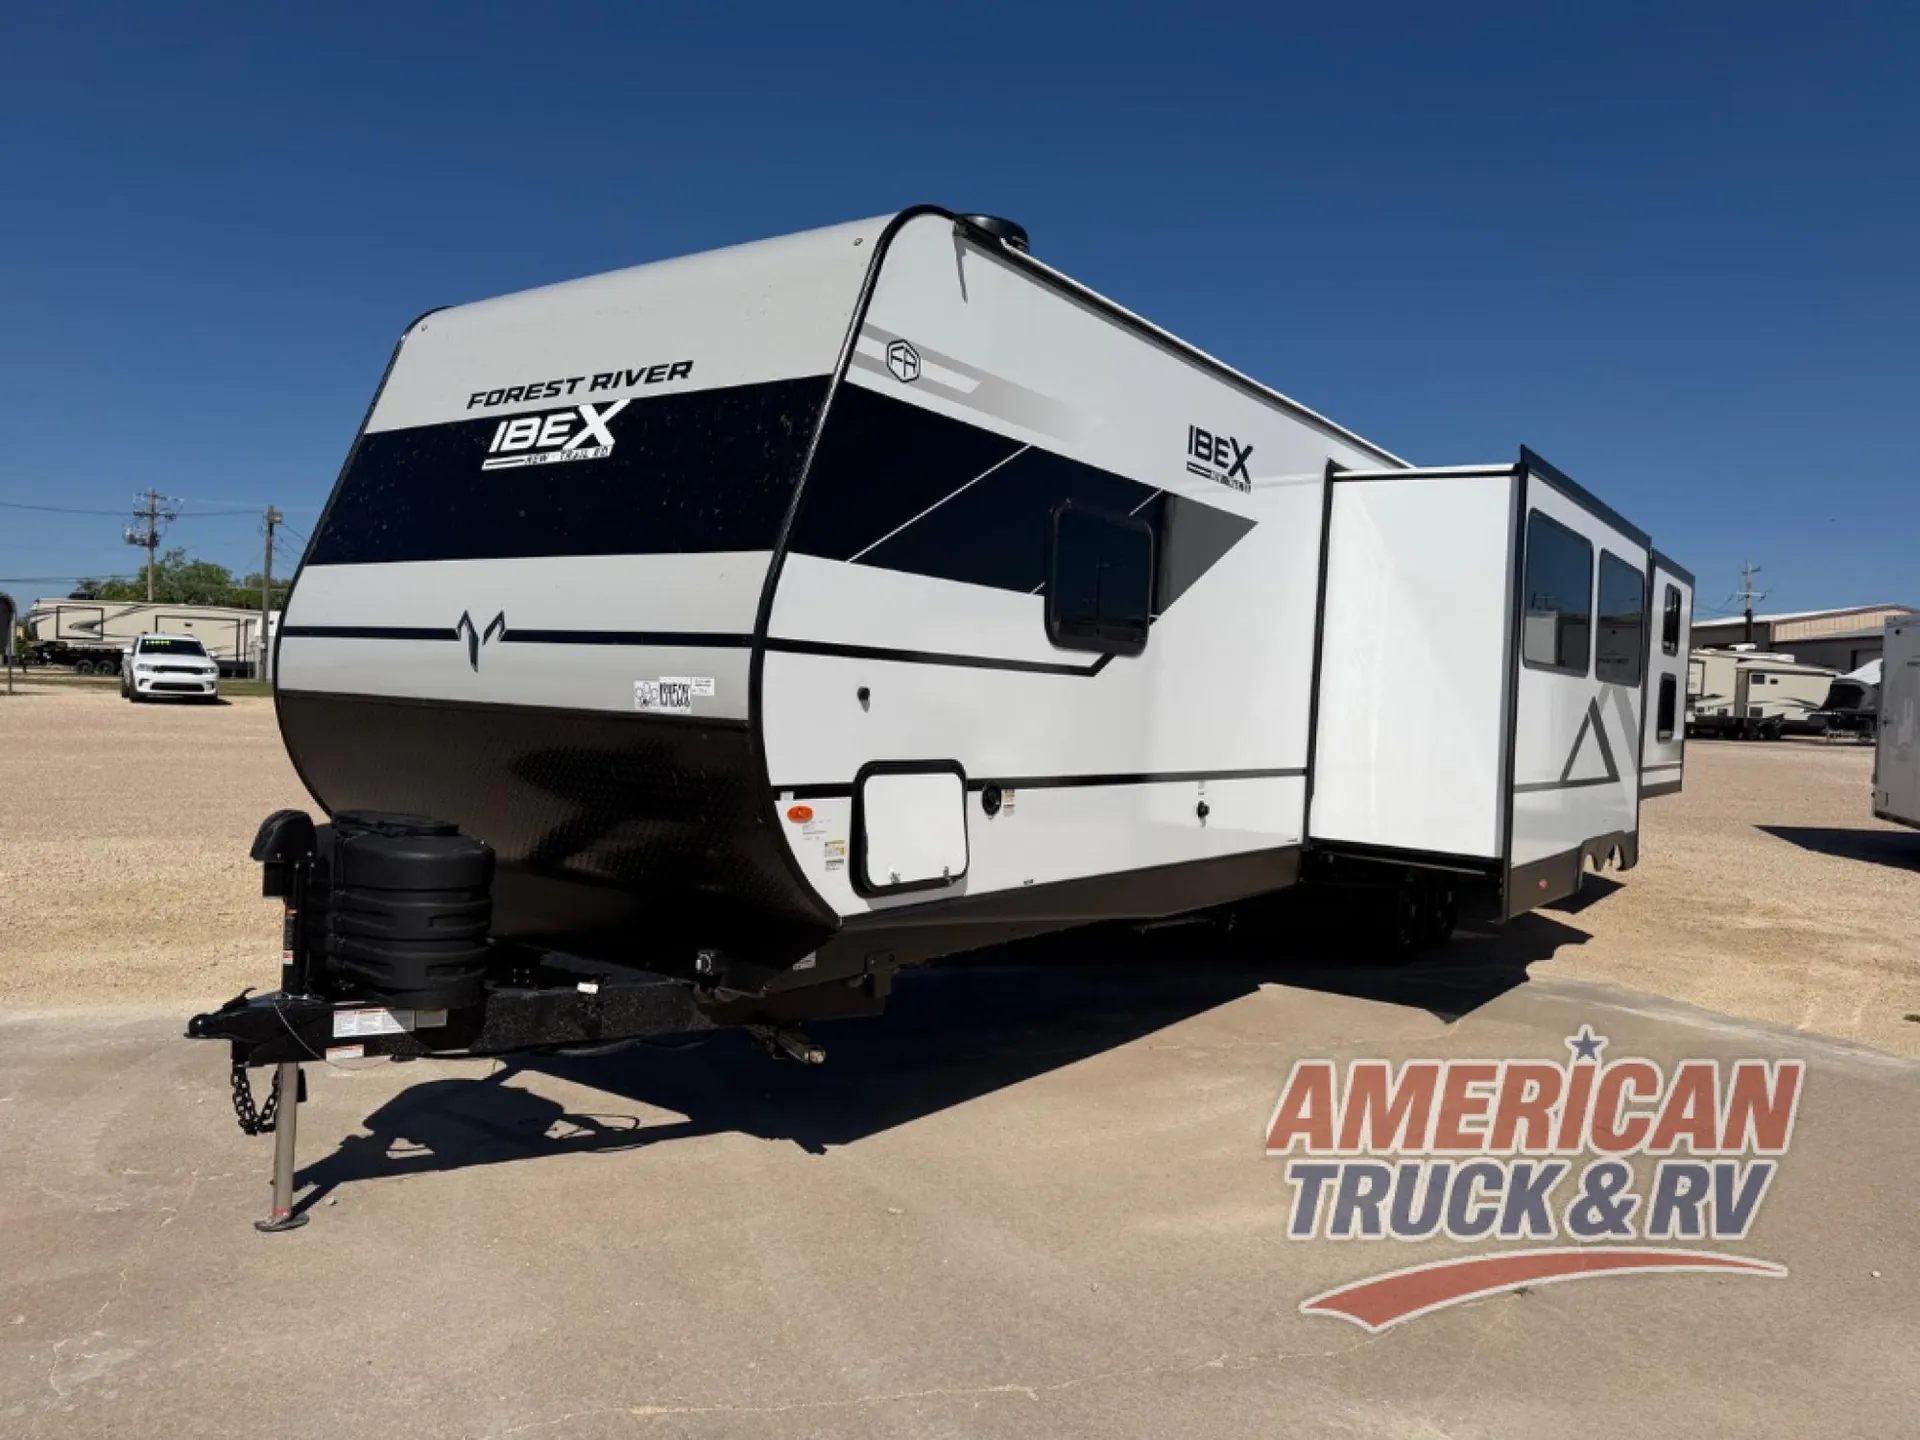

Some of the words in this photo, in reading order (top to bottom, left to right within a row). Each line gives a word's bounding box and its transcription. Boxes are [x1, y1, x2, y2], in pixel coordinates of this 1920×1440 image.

[467, 376, 586, 410] FOREST
[588, 359, 694, 393] RIVER
[488, 399, 631, 453] IBEX
[1187, 424, 1254, 485] IBEX
